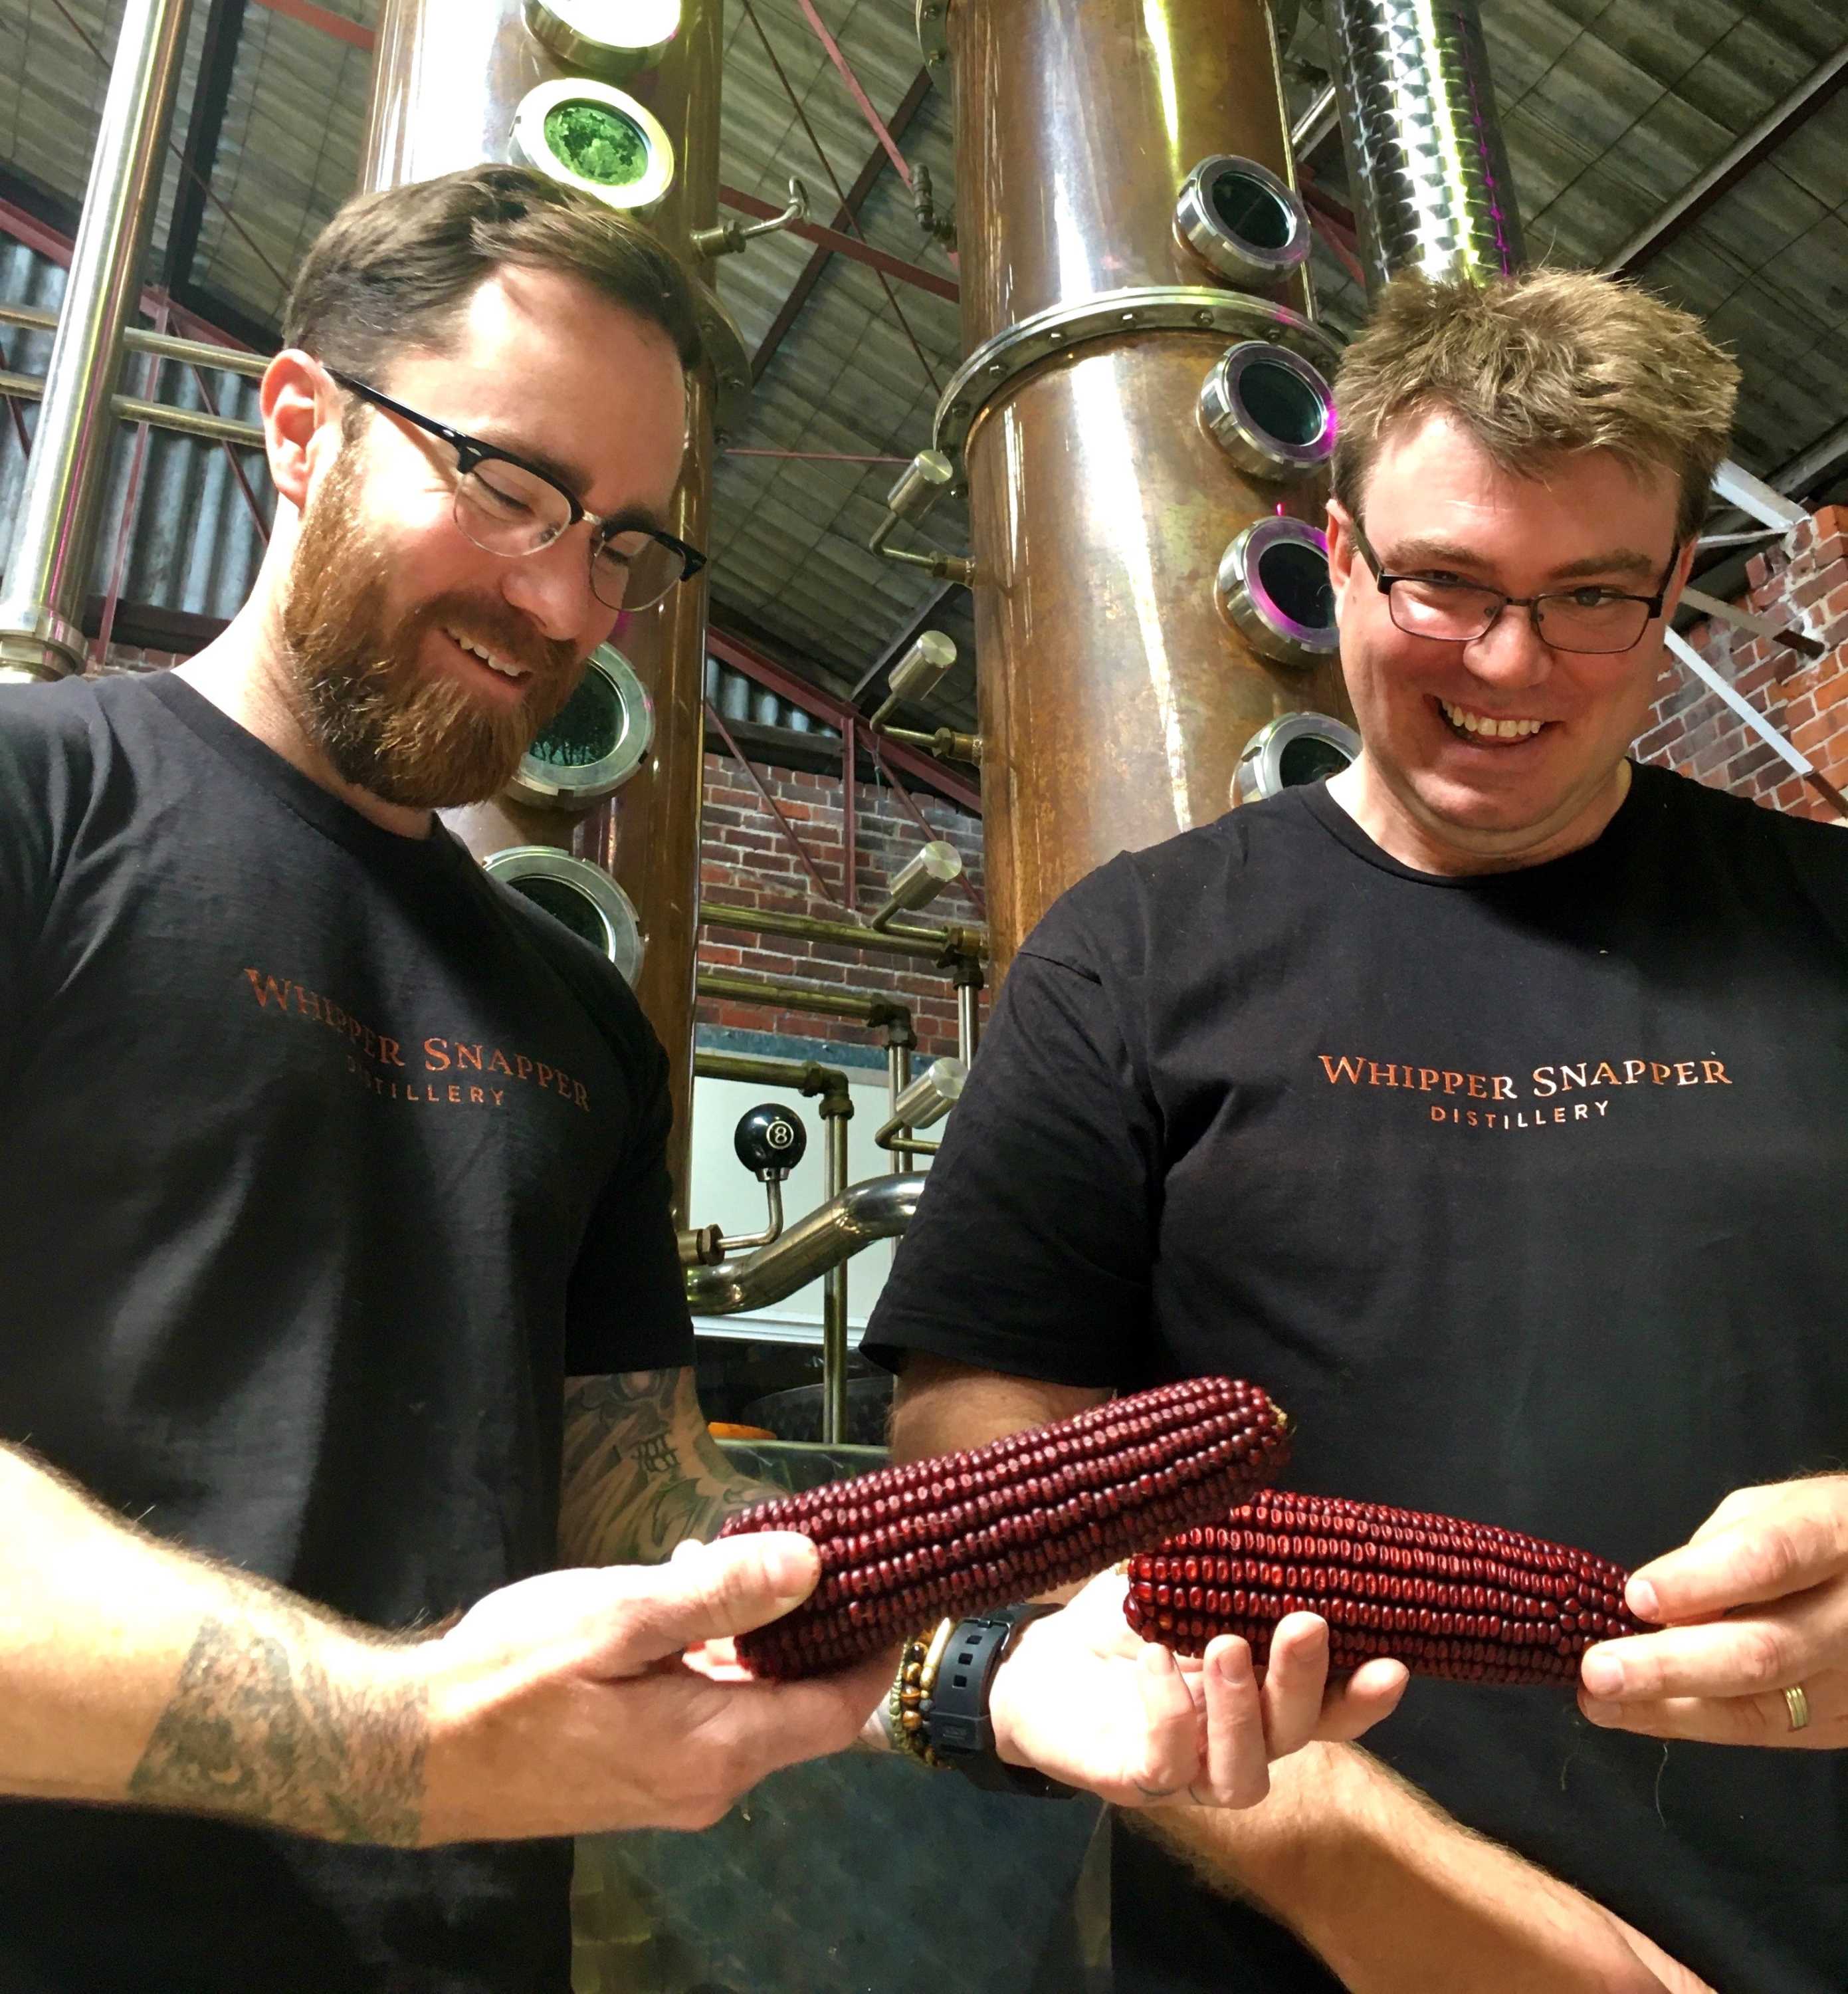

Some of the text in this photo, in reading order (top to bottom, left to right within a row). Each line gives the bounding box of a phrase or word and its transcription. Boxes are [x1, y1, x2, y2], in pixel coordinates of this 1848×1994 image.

[243, 968, 590, 1111] WHIPPER SNAPPER
[348, 1055, 504, 1105] DTILLERY
[1318, 1055, 1732, 1100] WHIPPER SNAPPER
[775, 1126, 787, 1144] 8
[1431, 1100, 1609, 1130] DISTILLERY
